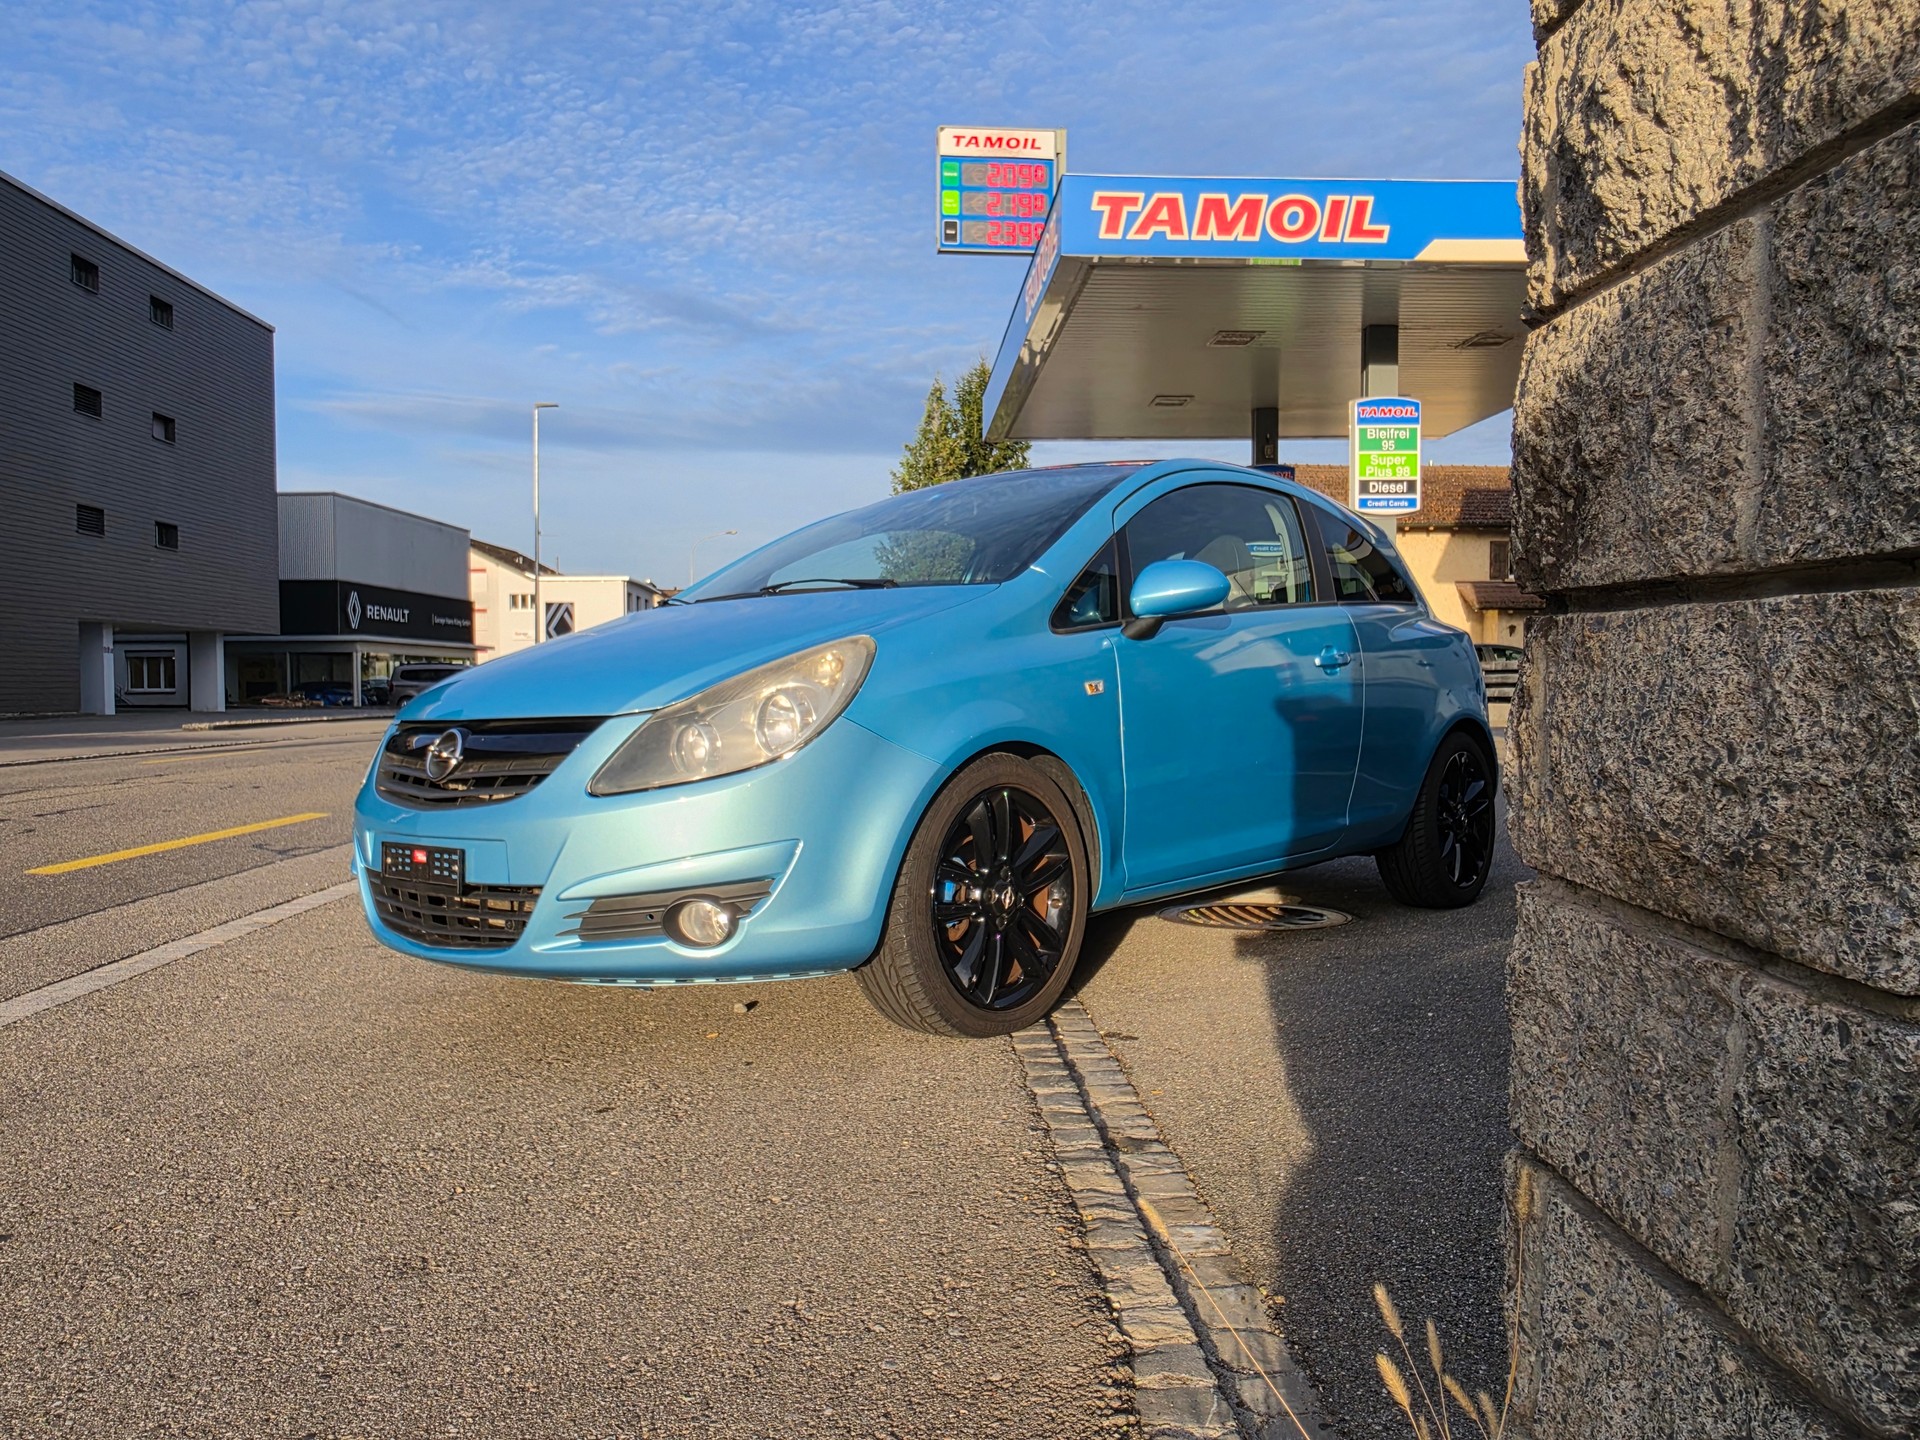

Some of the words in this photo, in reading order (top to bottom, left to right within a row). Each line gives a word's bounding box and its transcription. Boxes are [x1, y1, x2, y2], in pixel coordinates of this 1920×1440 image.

[952, 135, 1042, 150] TAMOIL
[1090, 190, 1391, 244] TAMOIL
[1358, 406, 1418, 418] TAMOIL
[1367, 428, 1410, 439] Bleifrei
[1381, 440, 1395, 451] 95
[1370, 454, 1407, 466] Super
[1365, 466, 1393, 477] Plus
[1395, 466, 1411, 477] 98
[1369, 482, 1407, 493] Diesel
[367, 604, 410, 624] RENAULT
